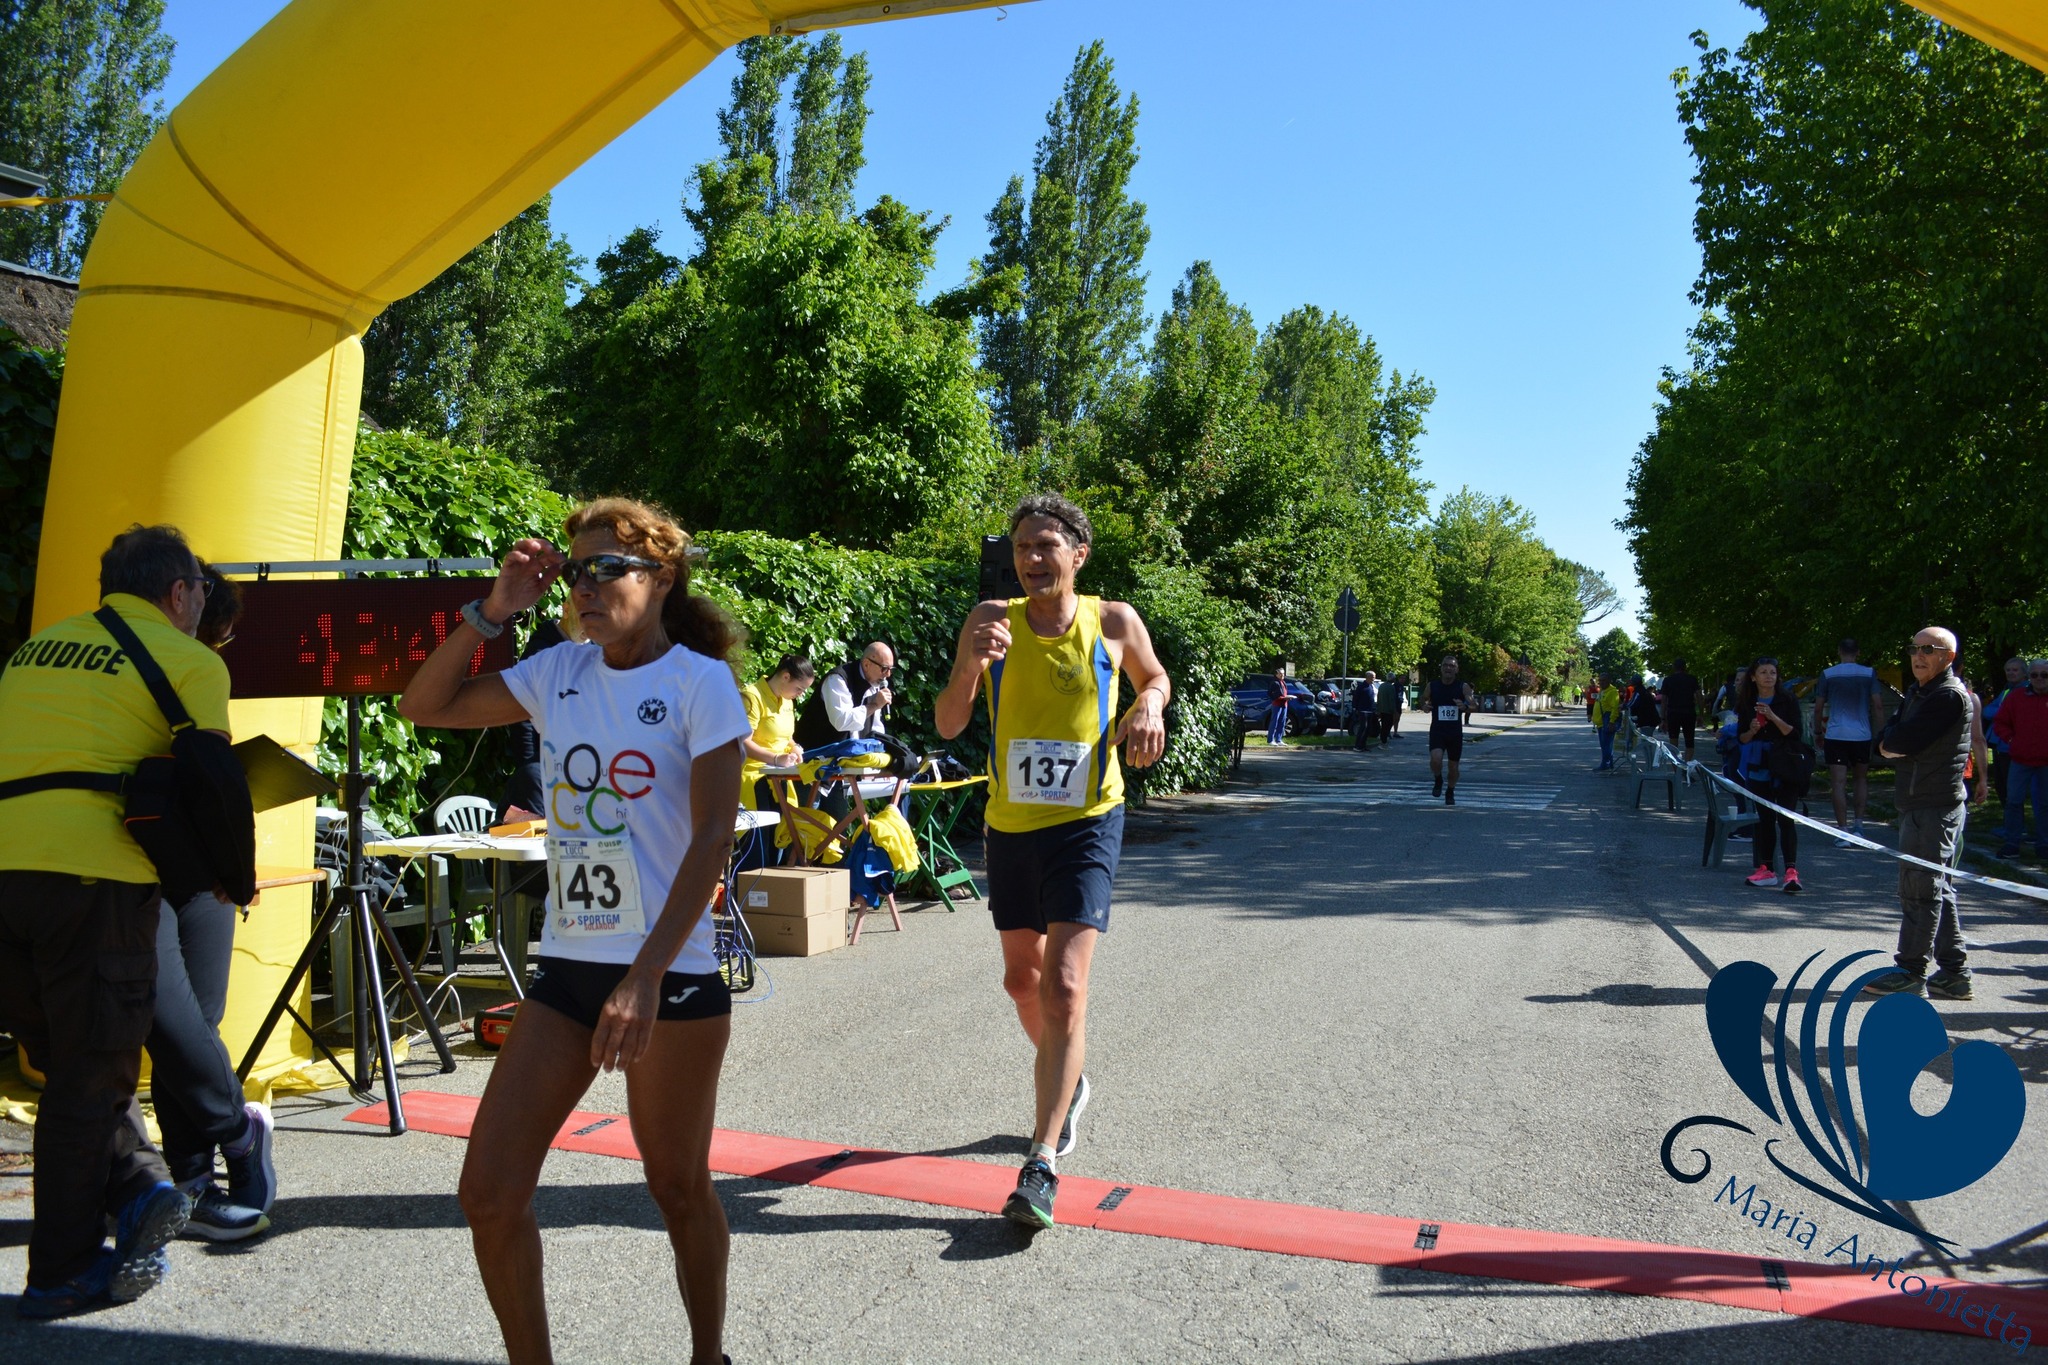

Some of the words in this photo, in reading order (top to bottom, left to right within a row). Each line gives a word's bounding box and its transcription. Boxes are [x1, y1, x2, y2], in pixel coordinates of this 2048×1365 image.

[11, 640, 126, 676] GIUDICE
[1441, 709, 1456, 717] 182
[1018, 756, 1077, 788] 137
[577, 914, 621, 926] SPORTGM
